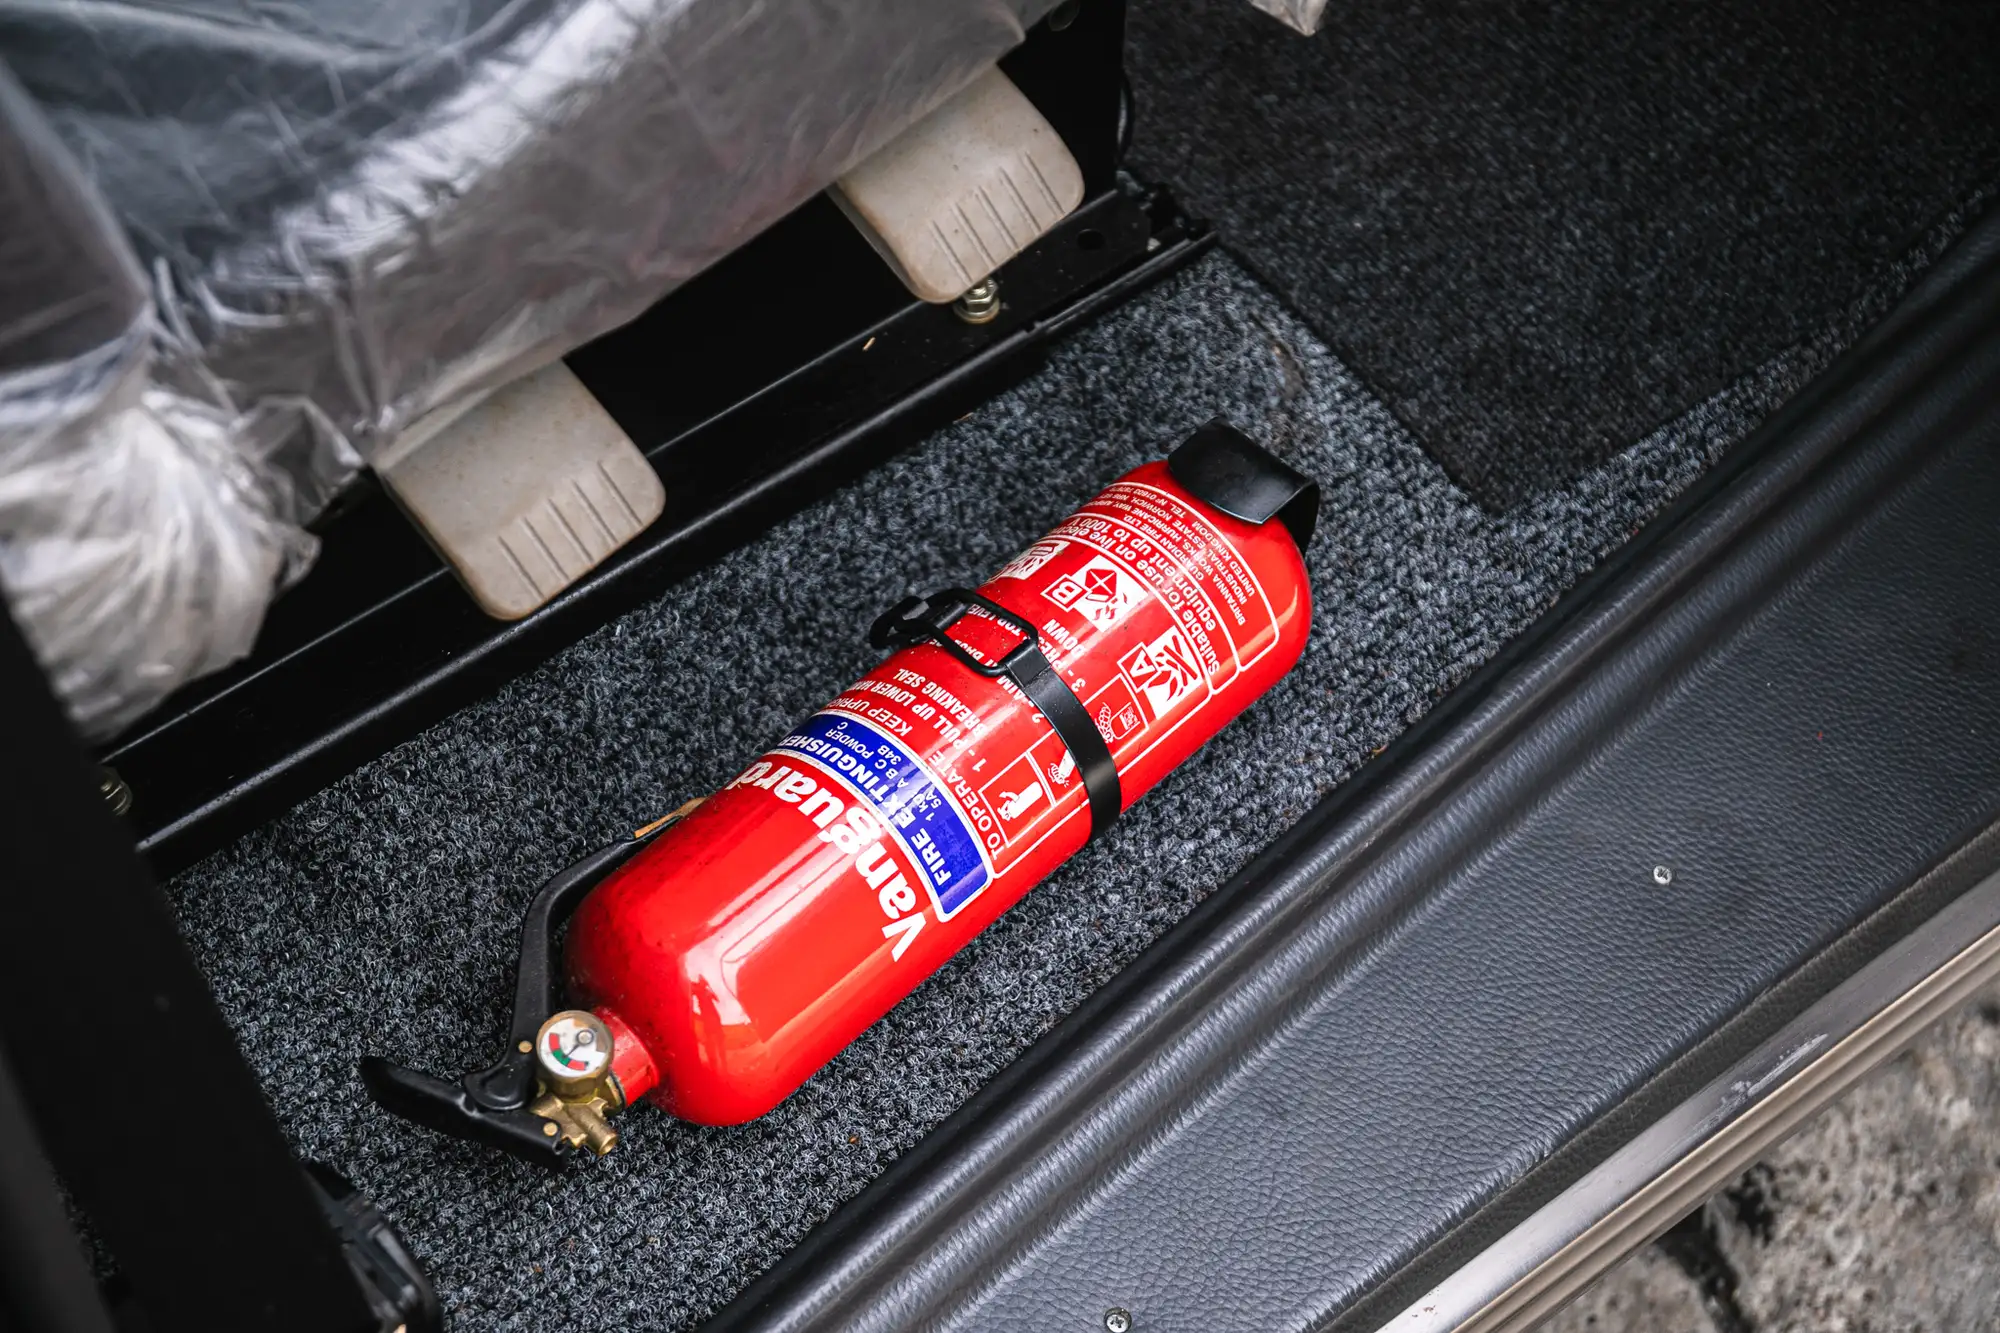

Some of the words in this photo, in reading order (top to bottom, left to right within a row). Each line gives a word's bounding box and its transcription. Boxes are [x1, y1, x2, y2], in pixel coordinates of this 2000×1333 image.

[1081, 518, 1113, 533] 1000
[1123, 513, 1142, 525] LTD.
[1133, 505, 1182, 540] HURRICANE
[1140, 522, 1161, 539] FIRE
[1090, 530, 1116, 550] live
[1115, 527, 1130, 540] to
[1130, 537, 1150, 554] up
[1172, 519, 1205, 548] ESTATE
[1192, 520, 1231, 560] KINGDOM
[1114, 542, 1137, 559] on
[1159, 536, 1204, 579] GUARDIAN
[1181, 538, 1215, 574] WORKS,
[1136, 558, 1165, 585] use
[1207, 548, 1247, 604] INDUSTRIAL
[1229, 560, 1255, 596] UNITED
[1053, 580, 1082, 603] B
[1147, 550, 1216, 630] equipment
[1161, 584, 1185, 610] for
[1212, 572, 1246, 625] BRITANNIA
[967, 603, 995, 621] LEVE
[1042, 618, 1085, 658] DOWN
[1179, 608, 1220, 674] Suitable
[1128, 649, 1155, 676] A
[893, 668, 926, 688] SEAL
[997, 675, 1027, 701] AIM
[1071, 678, 1086, 692] 3
[870, 681, 916, 707] LOWER
[867, 708, 913, 737] KEEP
[911, 703, 936, 720] UP
[920, 682, 988, 738] BREAKING
[836, 721, 848, 730] C
[931, 714, 971, 750] PULL
[825, 728, 874, 759] POWDER
[877, 744, 901, 765] 34B
[874, 759, 887, 769] C
[885, 768, 899, 779] B
[971, 757, 987, 771] 1
[777, 733, 916, 828] EXTINGUISHER
[897, 777, 909, 788] A
[928, 749, 993, 830] OPERATE
[925, 790, 941, 809] 5A
[925, 812, 935, 821] 1
[910, 827, 952, 885] FIRE
[986, 833, 1004, 860] TO
[725, 760, 924, 962] Vanguard
